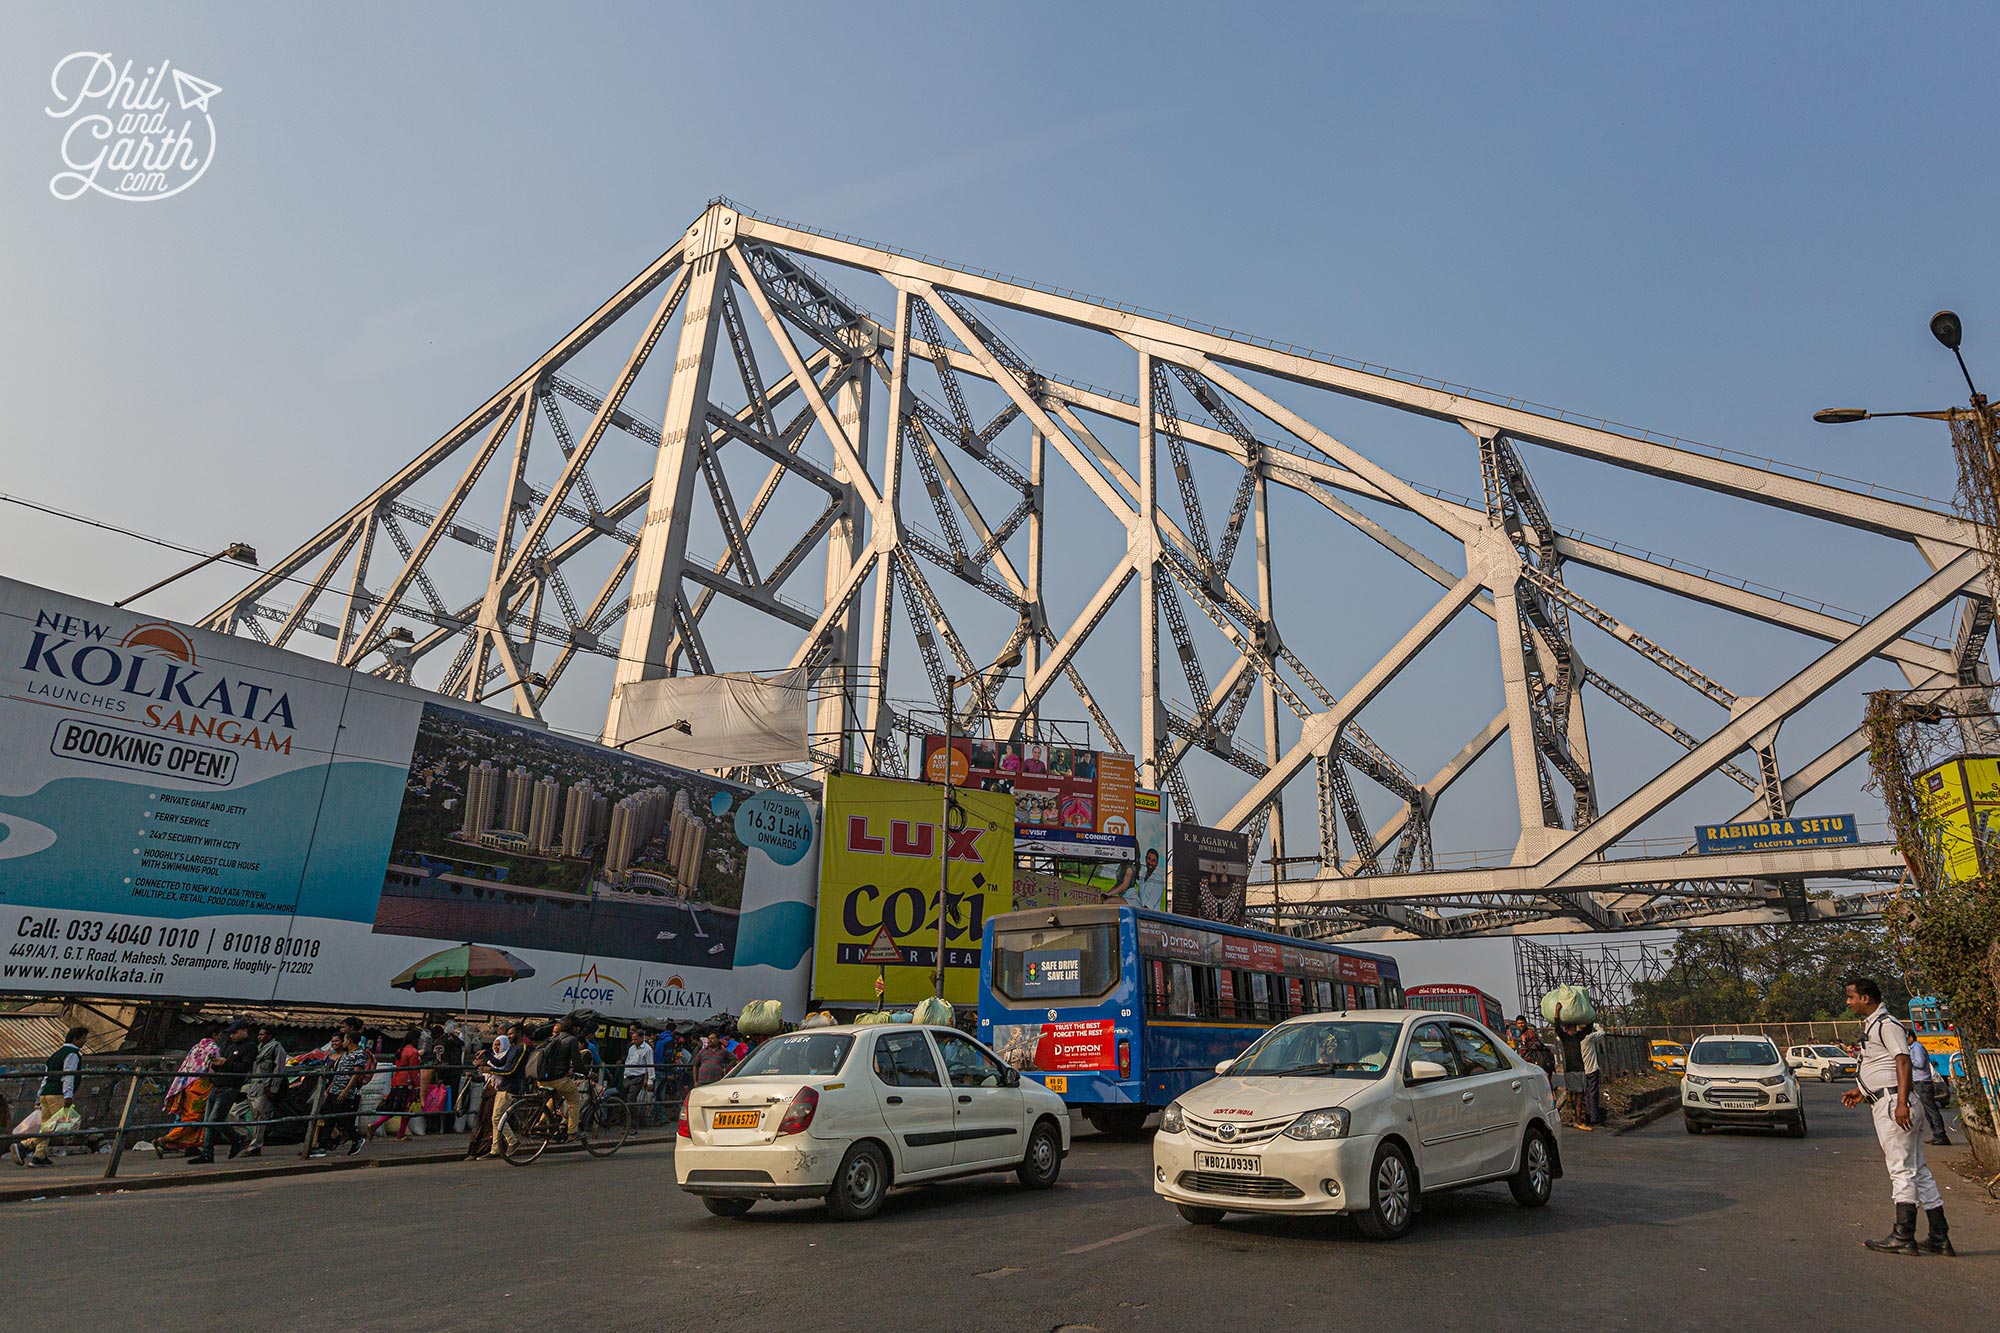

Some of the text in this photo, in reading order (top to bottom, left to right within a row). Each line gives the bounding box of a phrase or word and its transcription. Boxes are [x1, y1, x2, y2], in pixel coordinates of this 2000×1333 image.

[34, 609, 111, 642] NEW
[19, 630, 297, 730] KOLKATA
[27, 681, 126, 712] LAUNCHES
[142, 704, 292, 756] SANGAM
[63, 725, 231, 779] BOOKING OPEN!
[160, 794, 191, 806] PRIVATE
[210, 803, 225, 812] AND
[225, 806, 247, 815] JETTY
[763, 800, 800, 819] 1/2/3 BHK
[1135, 797, 1158, 807] aazar
[154, 812, 210, 827] FERRY SERVICE
[748, 809, 810, 841] 16.3 Lakh
[1706, 817, 1843, 840] RABINDRA SETU
[149, 830, 241, 850] 24x7 SECURITY WITH CCTV
[758, 832, 797, 850] ONWARDS
[847, 814, 987, 863] LUX
[1020, 828, 1047, 836] REVISIT
[1076, 833, 1117, 841] RECONNECT
[1201, 836, 1238, 849] AGARWAL
[1753, 840, 1794, 849] CALCUTTA
[1797, 837, 1818, 845] PORT
[1822, 836, 1848, 844] TRUST
[141, 859, 219, 876] WITH SWIMMING POOL
[143, 849, 260, 871] HOOGHLY'S LARGEST CLUB HOUSE
[135, 878, 180, 891] CONNECTED
[182, 882, 191, 891] TO
[192, 883, 209, 892] NEW
[210, 886, 240, 897] KOLKATA
[206, 895, 226, 906] FOOD
[227, 898, 249, 908] COURT
[256, 902, 275, 911] MUCH
[843, 872, 986, 942] cozi
[17, 915, 60, 939] Call:
[66, 919, 103, 942] 033
[106, 923, 152, 946] 4040
[158, 927, 199, 949] 1010
[223, 932, 271, 954] 81018
[274, 937, 320, 958] 81018
[1170, 936, 1199, 949] DYTRON
[9, 943, 59, 960] 449/A/1,
[63, 946, 84, 961] G.T.
[86, 948, 118, 964] Road,
[121, 950, 167, 966] Mahesh,
[171, 953, 230, 970] Serampore,
[279, 961, 314, 974] 712202
[1258, 944, 1276, 954] DYTRON
[4, 964, 164, 984] www.newkolkata.in
[1041, 960, 1079, 971] SAFE DRIVE
[644, 979, 664, 988] NEW
[1047, 970, 1078, 981] SAVE LIFE
[563, 986, 614, 1001] ALCOVE
[642, 987, 712, 1008] KOLKATA
[1064, 1044, 1101, 1053] DYTRON
[1204, 1155, 1259, 1172] WB02AD9391
